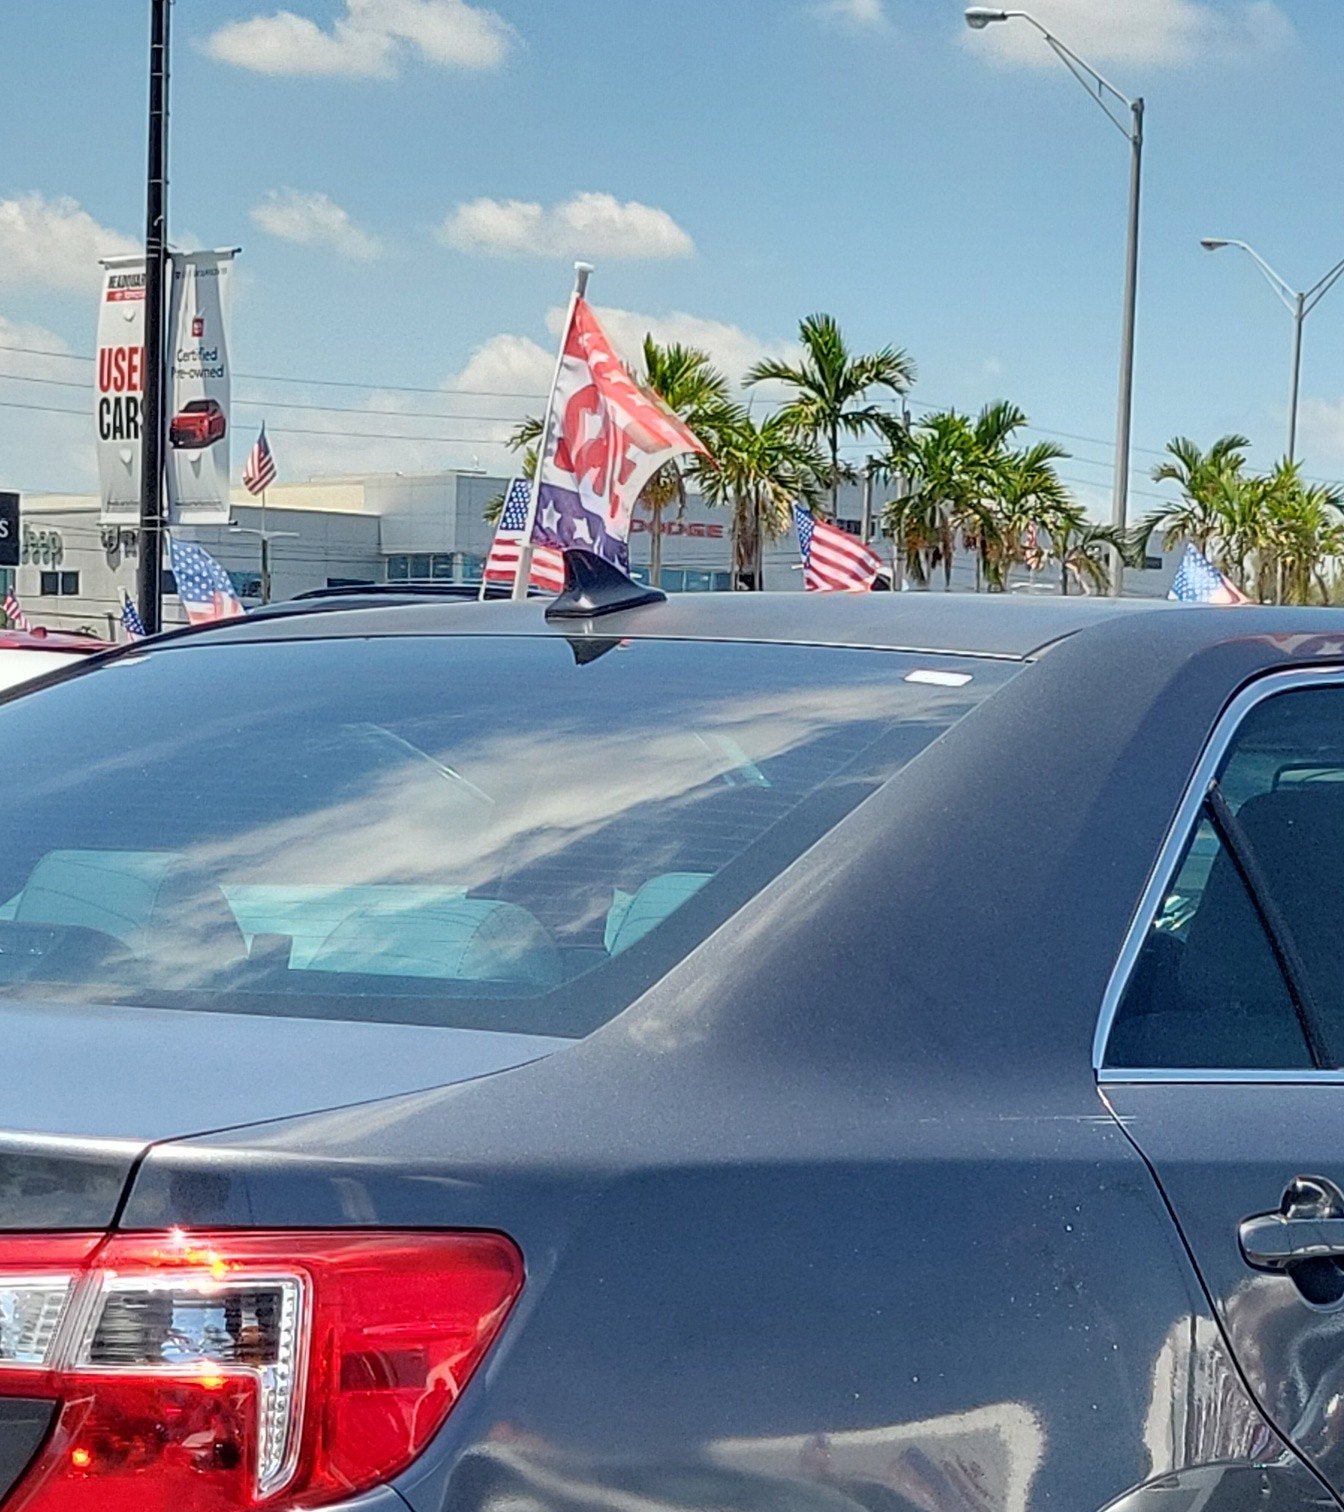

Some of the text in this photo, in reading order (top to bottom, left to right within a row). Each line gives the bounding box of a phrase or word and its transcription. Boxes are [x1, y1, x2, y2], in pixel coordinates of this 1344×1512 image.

[99, 347, 145, 393] USE
[99, 396, 145, 441] CAR
[630, 518, 723, 539] DODGE
